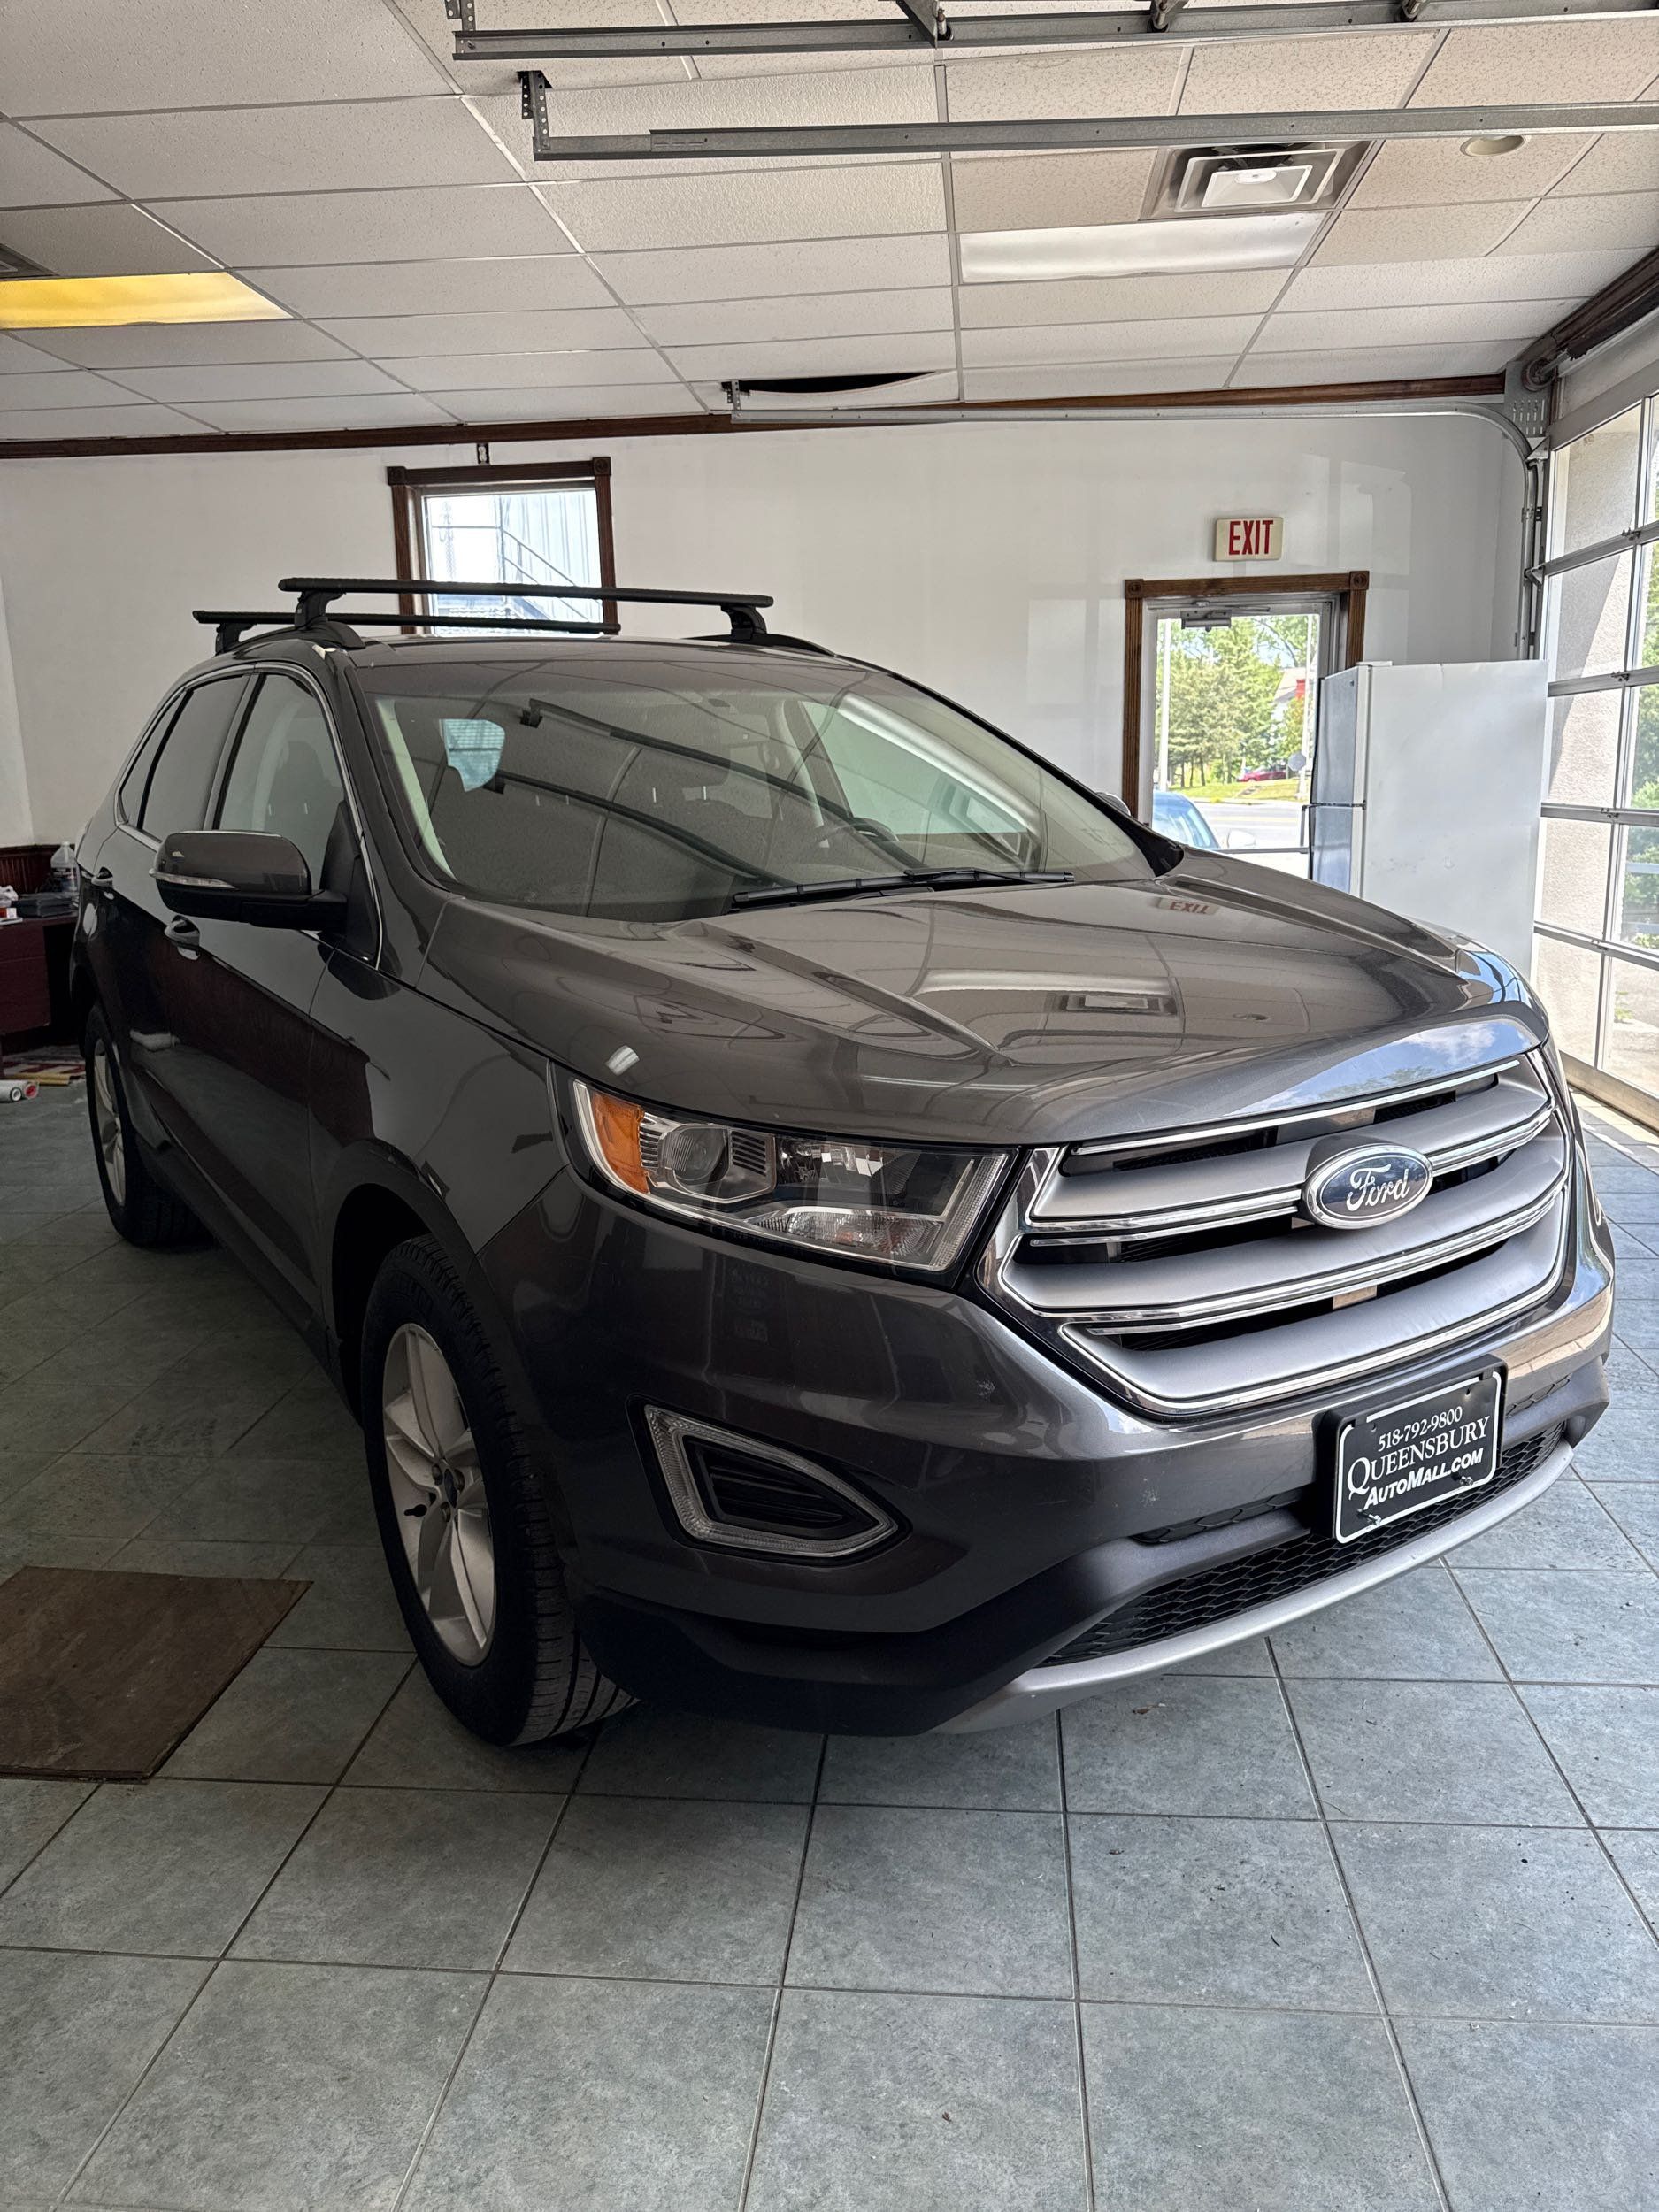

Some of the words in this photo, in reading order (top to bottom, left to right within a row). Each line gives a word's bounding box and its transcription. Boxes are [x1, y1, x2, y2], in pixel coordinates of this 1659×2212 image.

[1229, 520, 1273, 555] EXIT
[1346, 1164, 1410, 1211] Ford
[1378, 1406, 1463, 1452] 518-792-9800
[1347, 1416, 1490, 1500] QUEENSBURY
